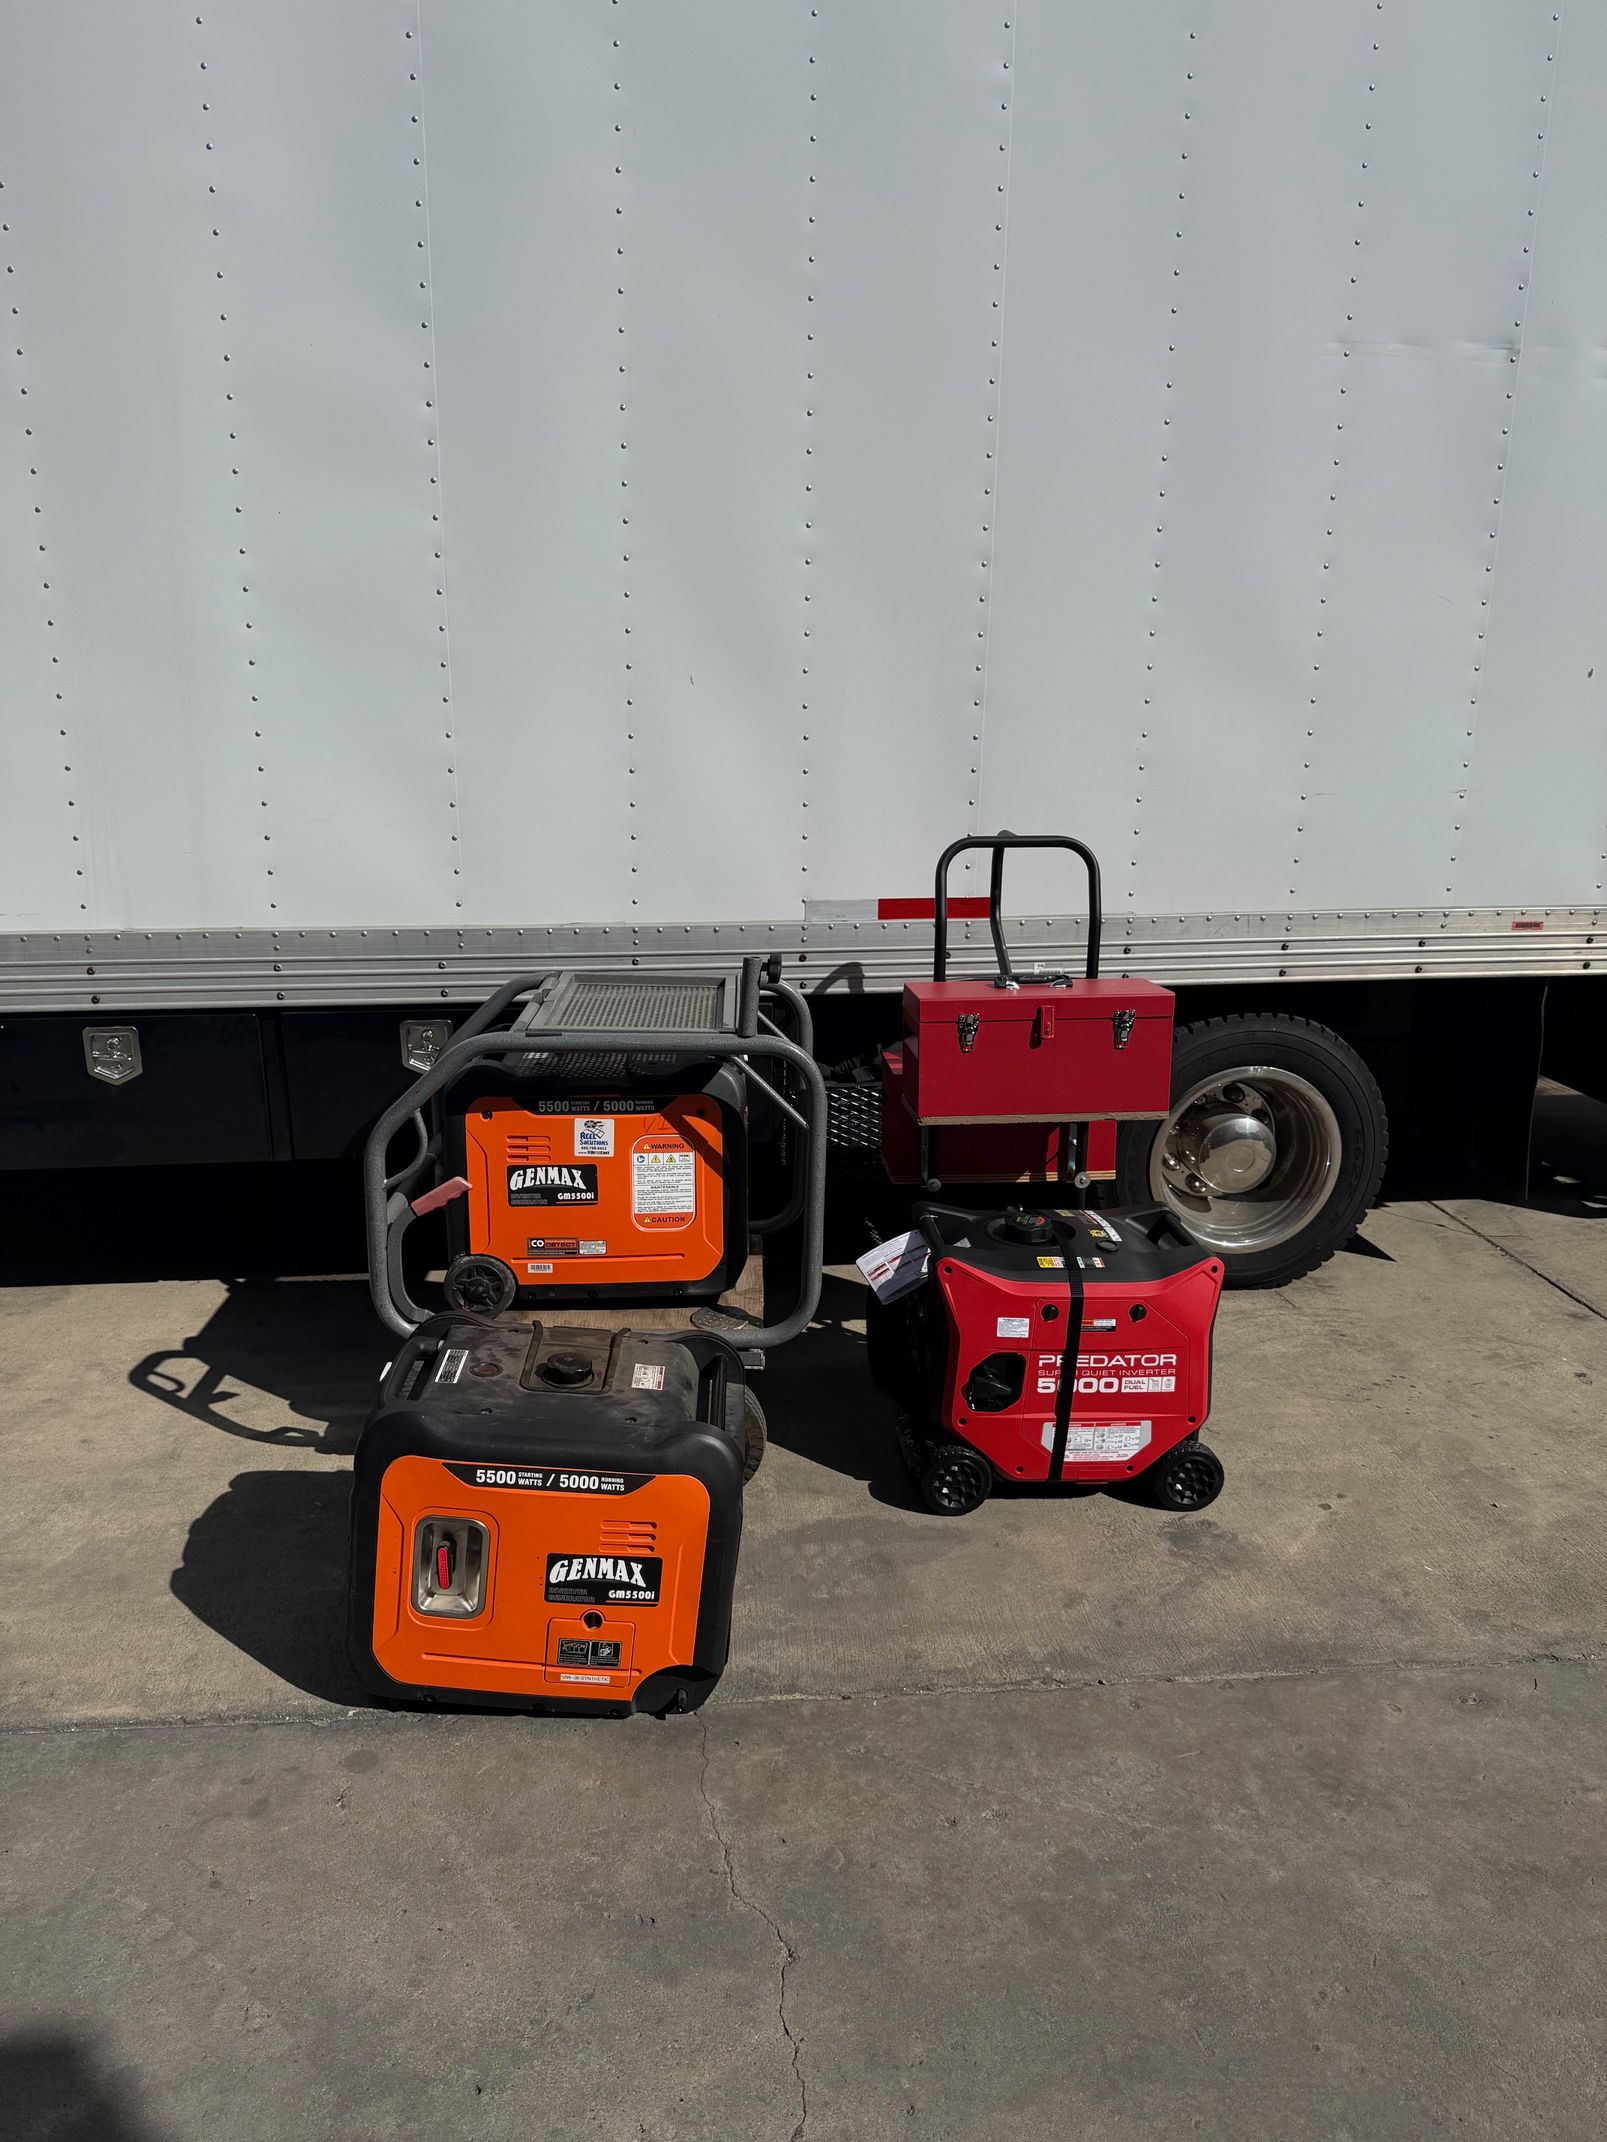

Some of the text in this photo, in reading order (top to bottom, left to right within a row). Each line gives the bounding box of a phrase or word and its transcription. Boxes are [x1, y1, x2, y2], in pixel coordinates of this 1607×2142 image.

[538, 1100, 570, 1112] 5500
[603, 1100, 634, 1112] 5000
[509, 1166, 587, 1191] GENMAX
[557, 1192, 595, 1200] GM5500i
[531, 1239, 545, 1247] CO
[1037, 1368, 1176, 1377] SUP QUIET INVERTER
[475, 1469, 517, 1485] 5500
[518, 1471, 543, 1479] STARTING
[546, 1473, 555, 1487] /
[518, 1478, 543, 1486] WATTS
[559, 1474, 599, 1490] 5000
[600, 1483, 625, 1491] WATTS
[549, 1557, 647, 1588] GENMAX
[608, 1590, 656, 1600] GM5500i
